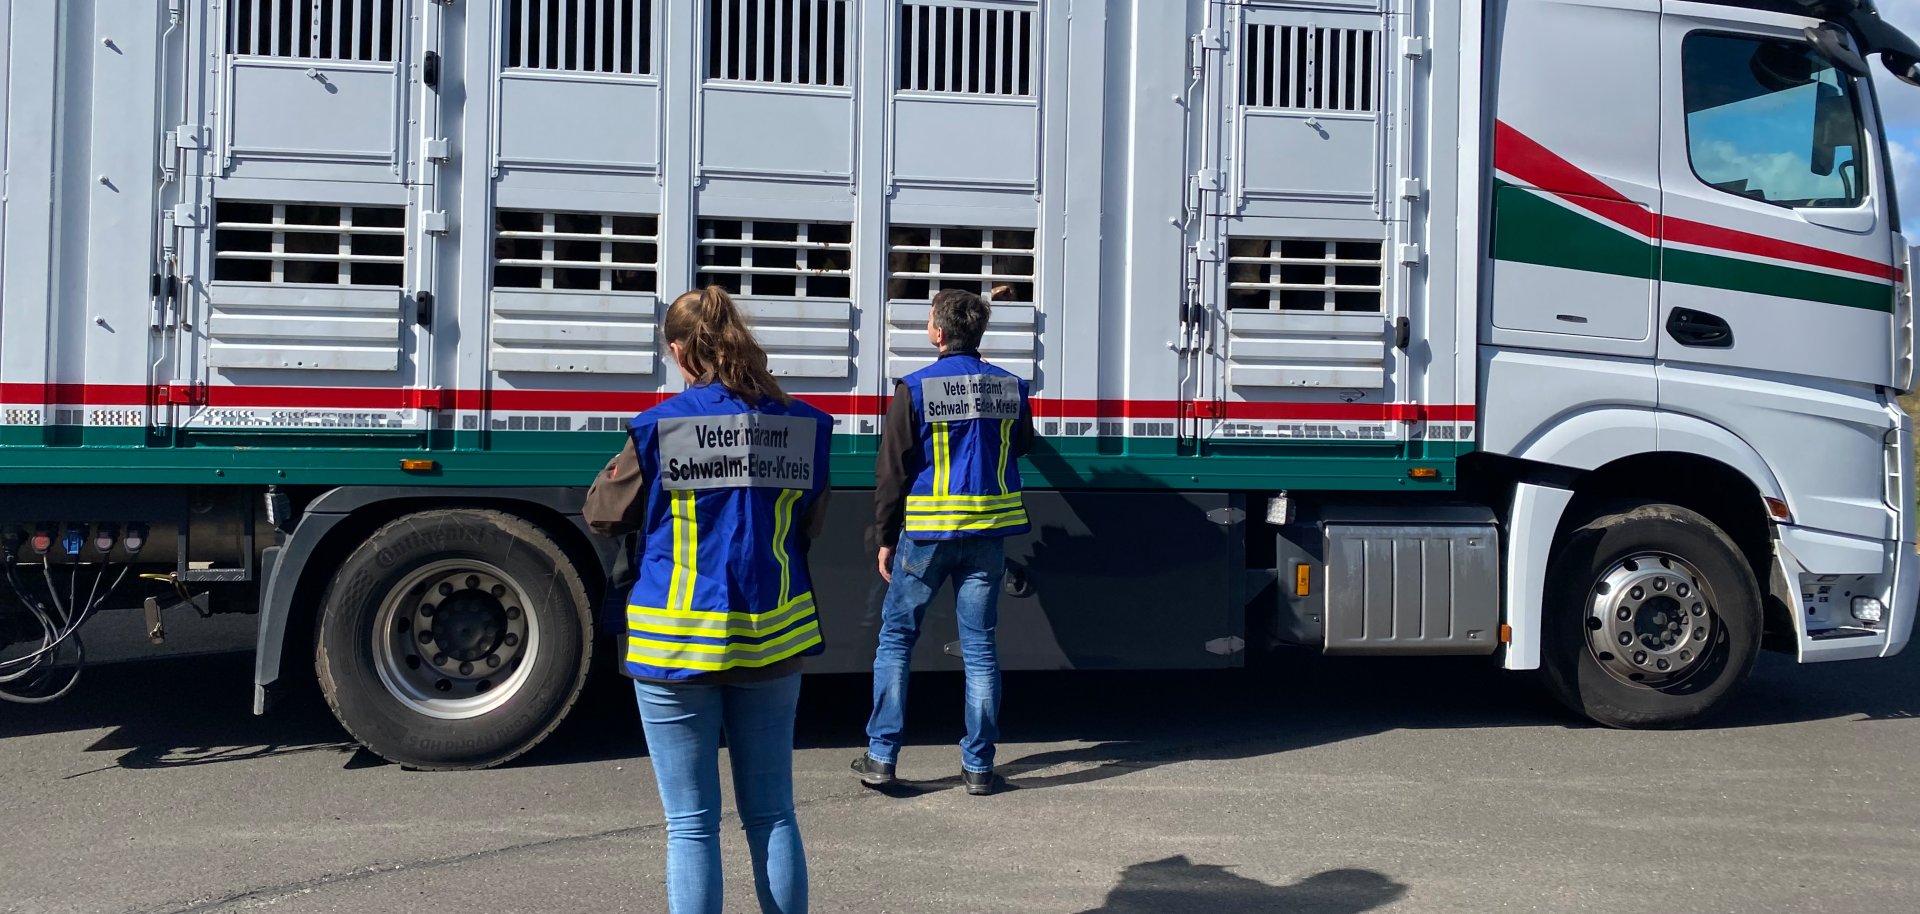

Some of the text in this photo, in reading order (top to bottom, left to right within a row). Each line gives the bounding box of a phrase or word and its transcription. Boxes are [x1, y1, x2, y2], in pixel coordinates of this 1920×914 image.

[695, 422, 789, 449] Veterinäramt
[375, 526, 486, 569] Continental
[444, 731, 497, 752] Hybrid
